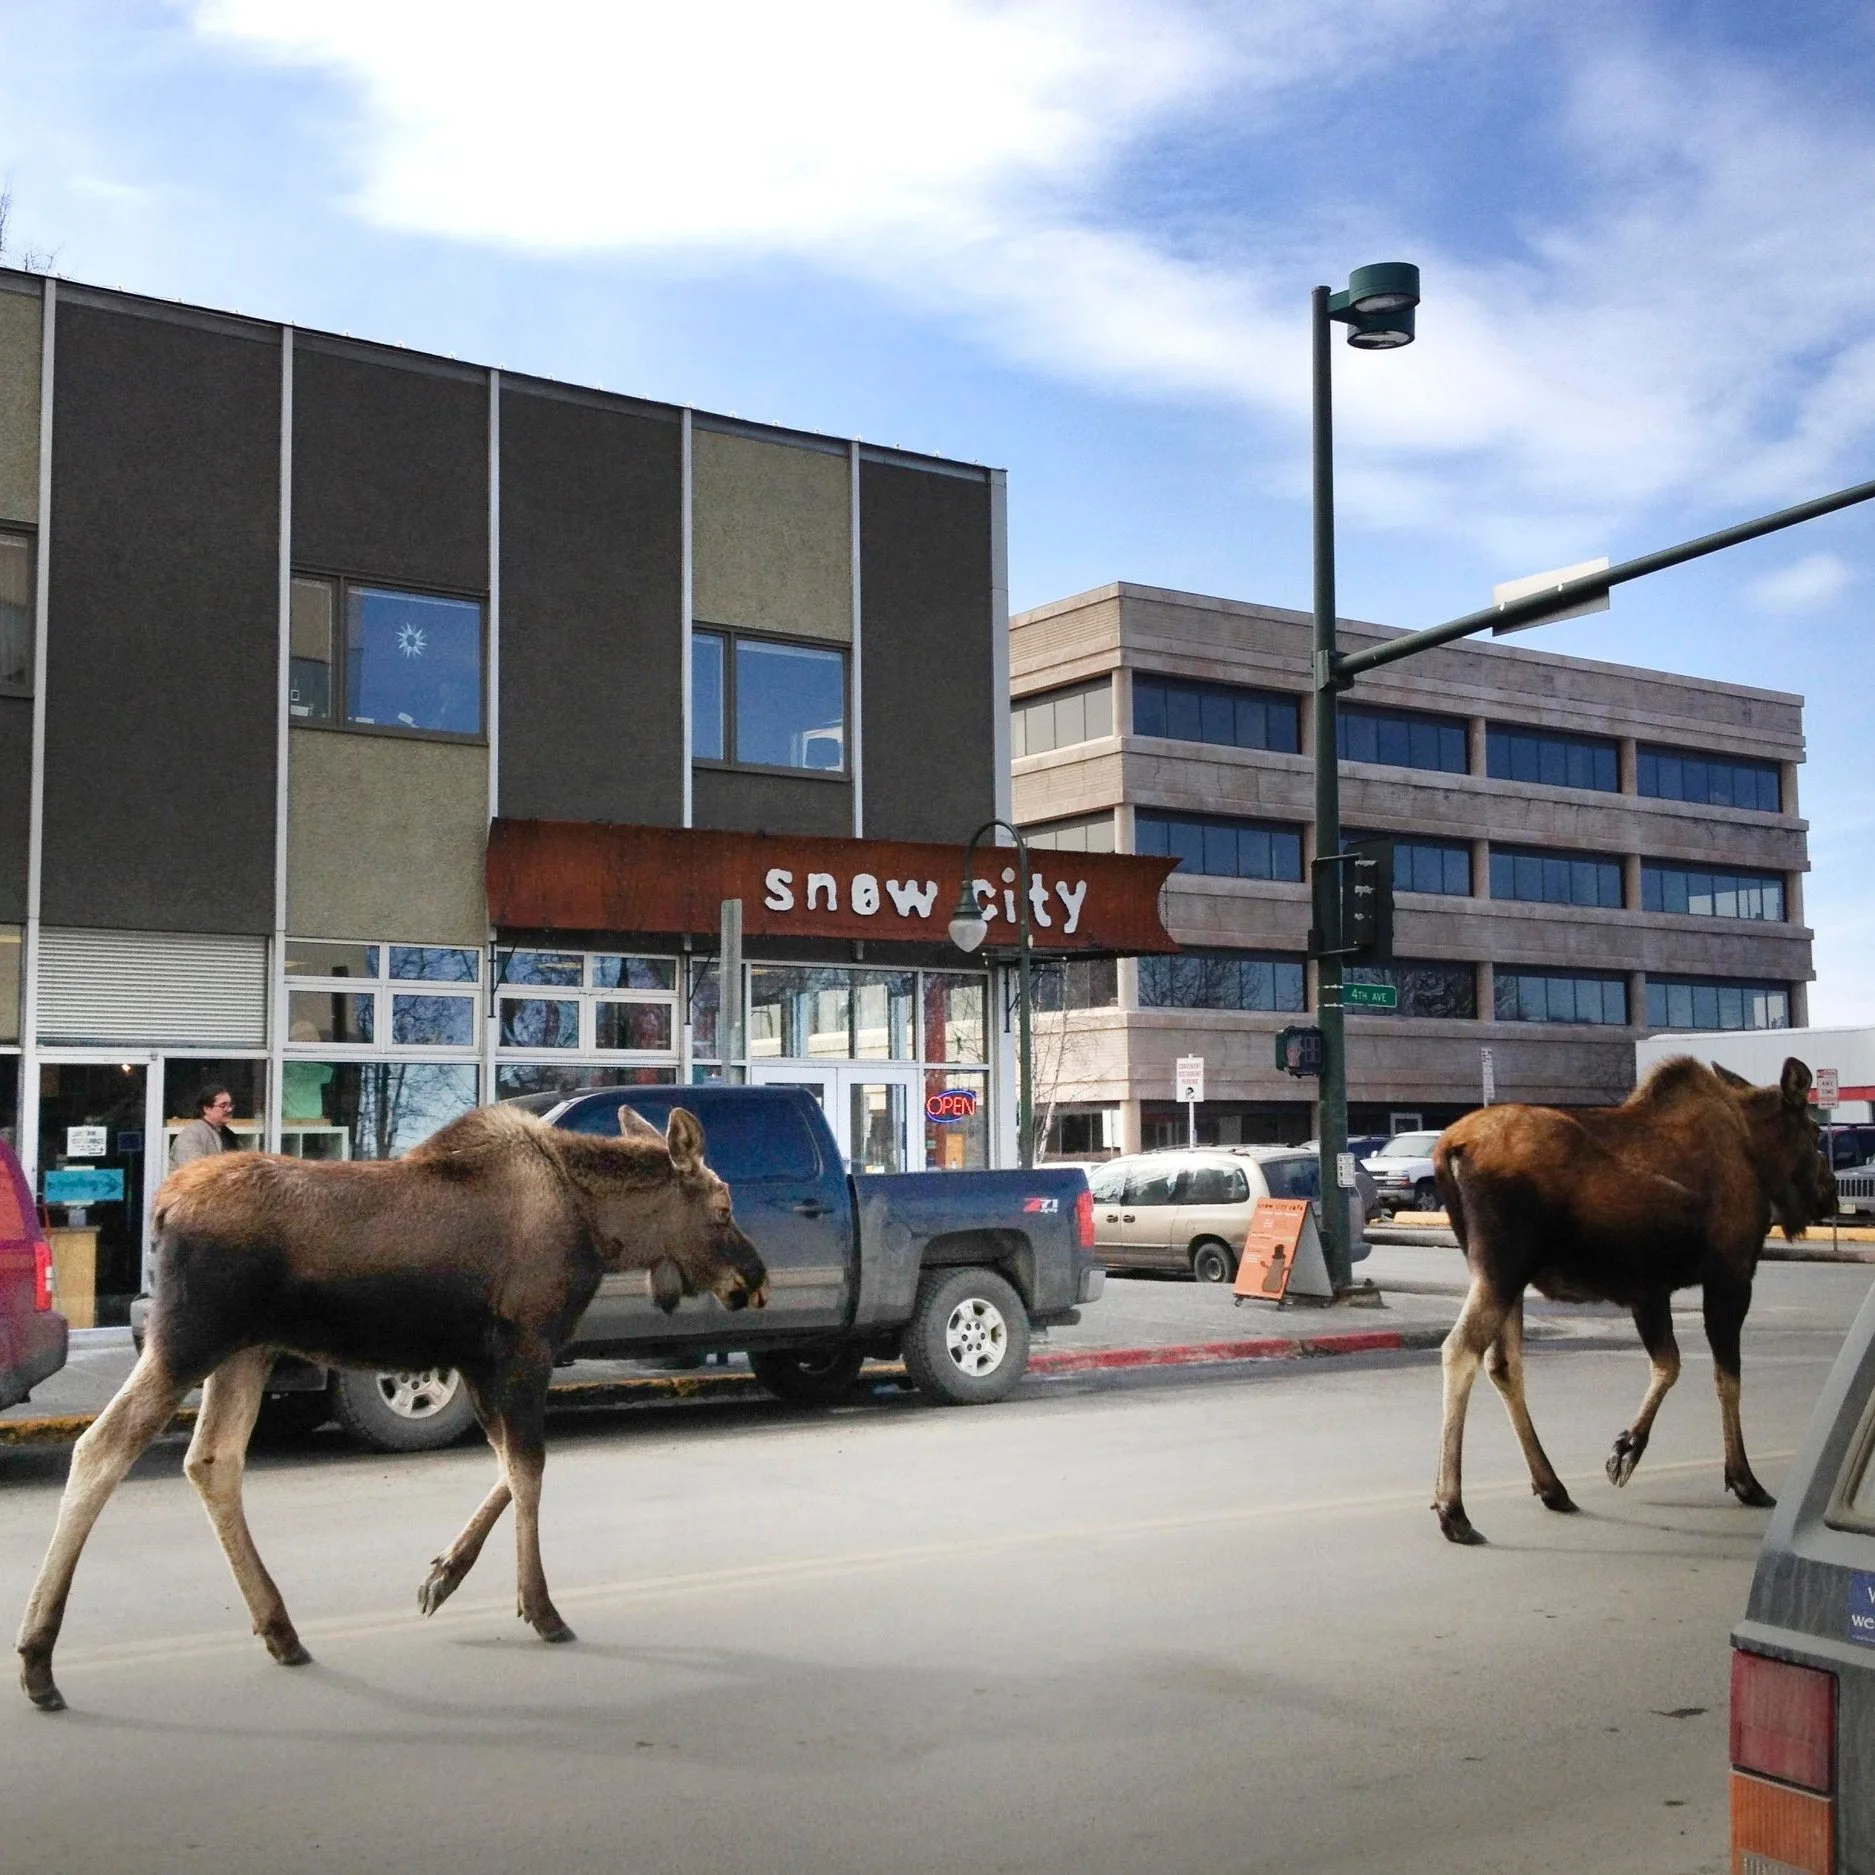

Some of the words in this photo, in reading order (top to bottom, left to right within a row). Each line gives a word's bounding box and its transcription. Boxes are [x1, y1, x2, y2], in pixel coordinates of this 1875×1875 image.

[764, 868, 938, 918] snow
[972, 867, 1087, 934] city
[1351, 988, 1368, 1000] 4TH
[1372, 992, 1387, 1002] AVE
[927, 1096, 976, 1116] OPEN
